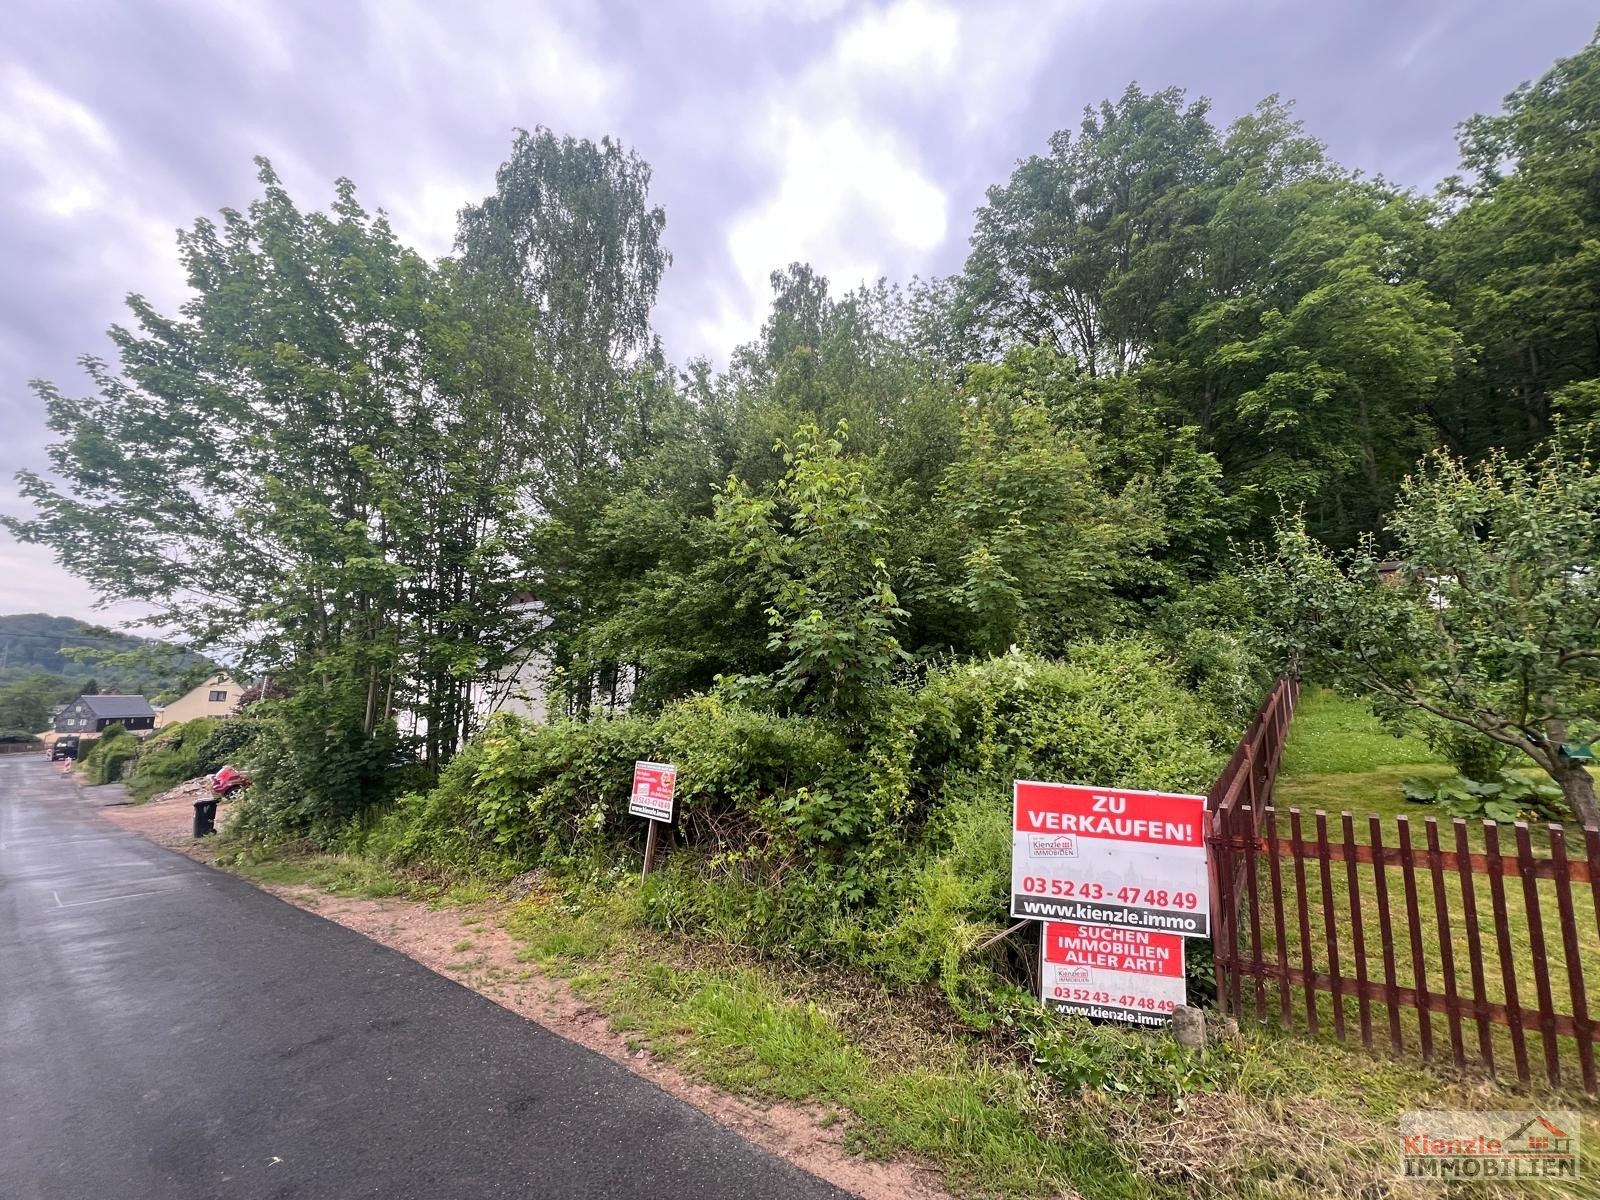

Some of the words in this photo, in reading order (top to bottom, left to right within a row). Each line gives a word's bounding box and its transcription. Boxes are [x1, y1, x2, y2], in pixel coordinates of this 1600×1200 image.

[1092, 795, 1126, 814] ZU
[1028, 811, 1193, 841] VERKAUFEN!
[1033, 841, 1061, 849] Kienzle
[1023, 877, 1047, 894] 03
[1051, 880, 1075, 897] 52
[1079, 883, 1103, 900] 43
[1117, 887, 1141, 904] 47
[1144, 889, 1168, 907] 48
[1173, 892, 1198, 910] 49
[1023, 902, 1196, 930] www.kienzle.immo
[1078, 926, 1149, 945] SUCHEN
[1058, 936, 1169, 960] IMMOBILIEN
[1065, 951, 1119, 968] ALLER
[1123, 958, 1163, 973] ART!
[1054, 986, 1070, 999] 03
[1073, 989, 1090, 1001] 52
[1093, 991, 1109, 1003] 43
[1119, 995, 1135, 1007] 47
[1137, 997, 1155, 1010] 48
[1158, 1000, 1175, 1012] 49
